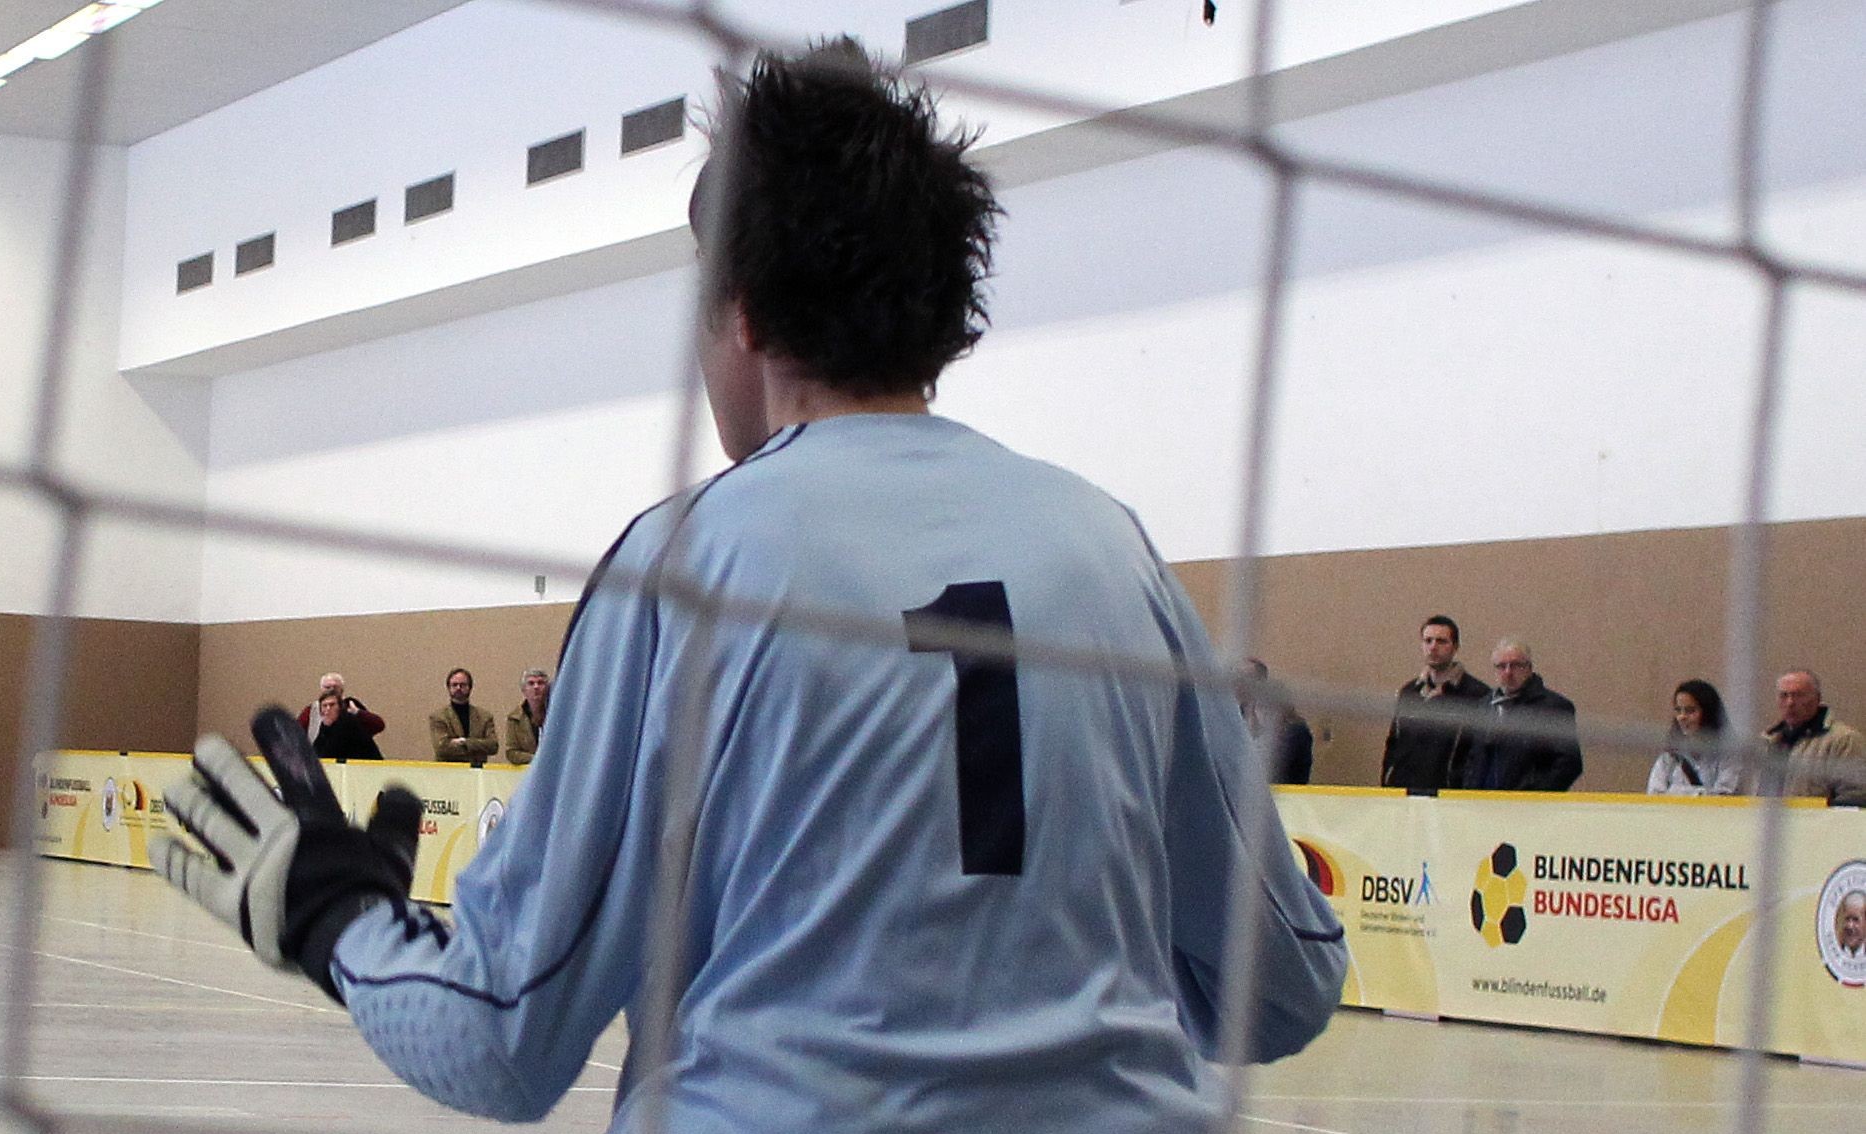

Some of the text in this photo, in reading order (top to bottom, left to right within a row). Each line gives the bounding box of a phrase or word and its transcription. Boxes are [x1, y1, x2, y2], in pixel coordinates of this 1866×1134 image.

[902, 581, 1025, 875] 1
[1534, 855, 1749, 891] BLINDENFUSSBALL
[1361, 876, 1414, 904] DBSV
[1534, 891, 1679, 924] BUNDESLIGA
[1472, 977, 1607, 1003] www.blindenfussball.de
